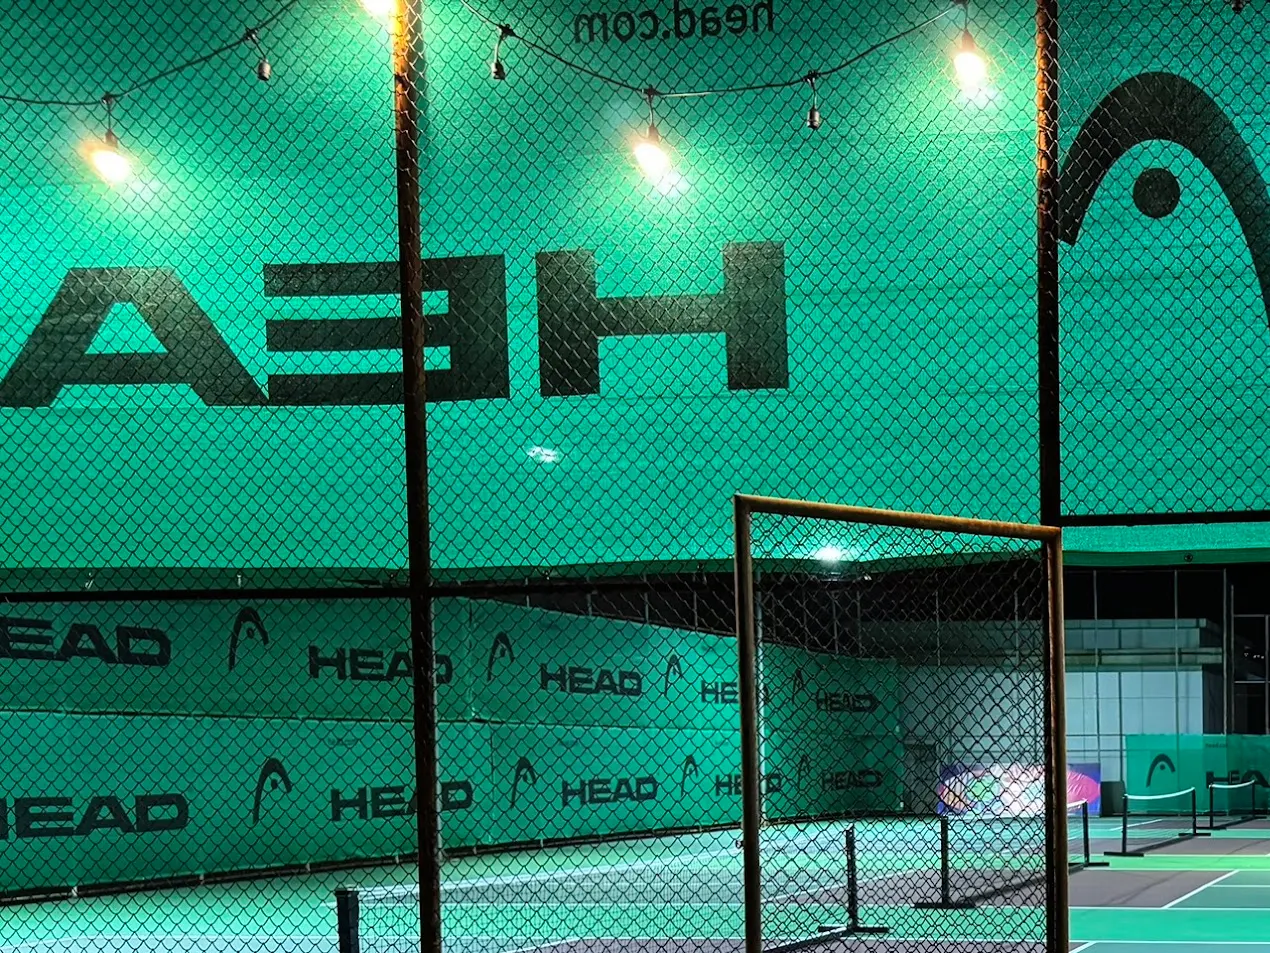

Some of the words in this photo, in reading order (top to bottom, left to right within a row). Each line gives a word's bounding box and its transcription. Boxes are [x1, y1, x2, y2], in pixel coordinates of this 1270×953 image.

[540, 663, 643, 697] HEAD
[562, 776, 659, 808] HEAD
[0, 793, 189, 841] EAD
